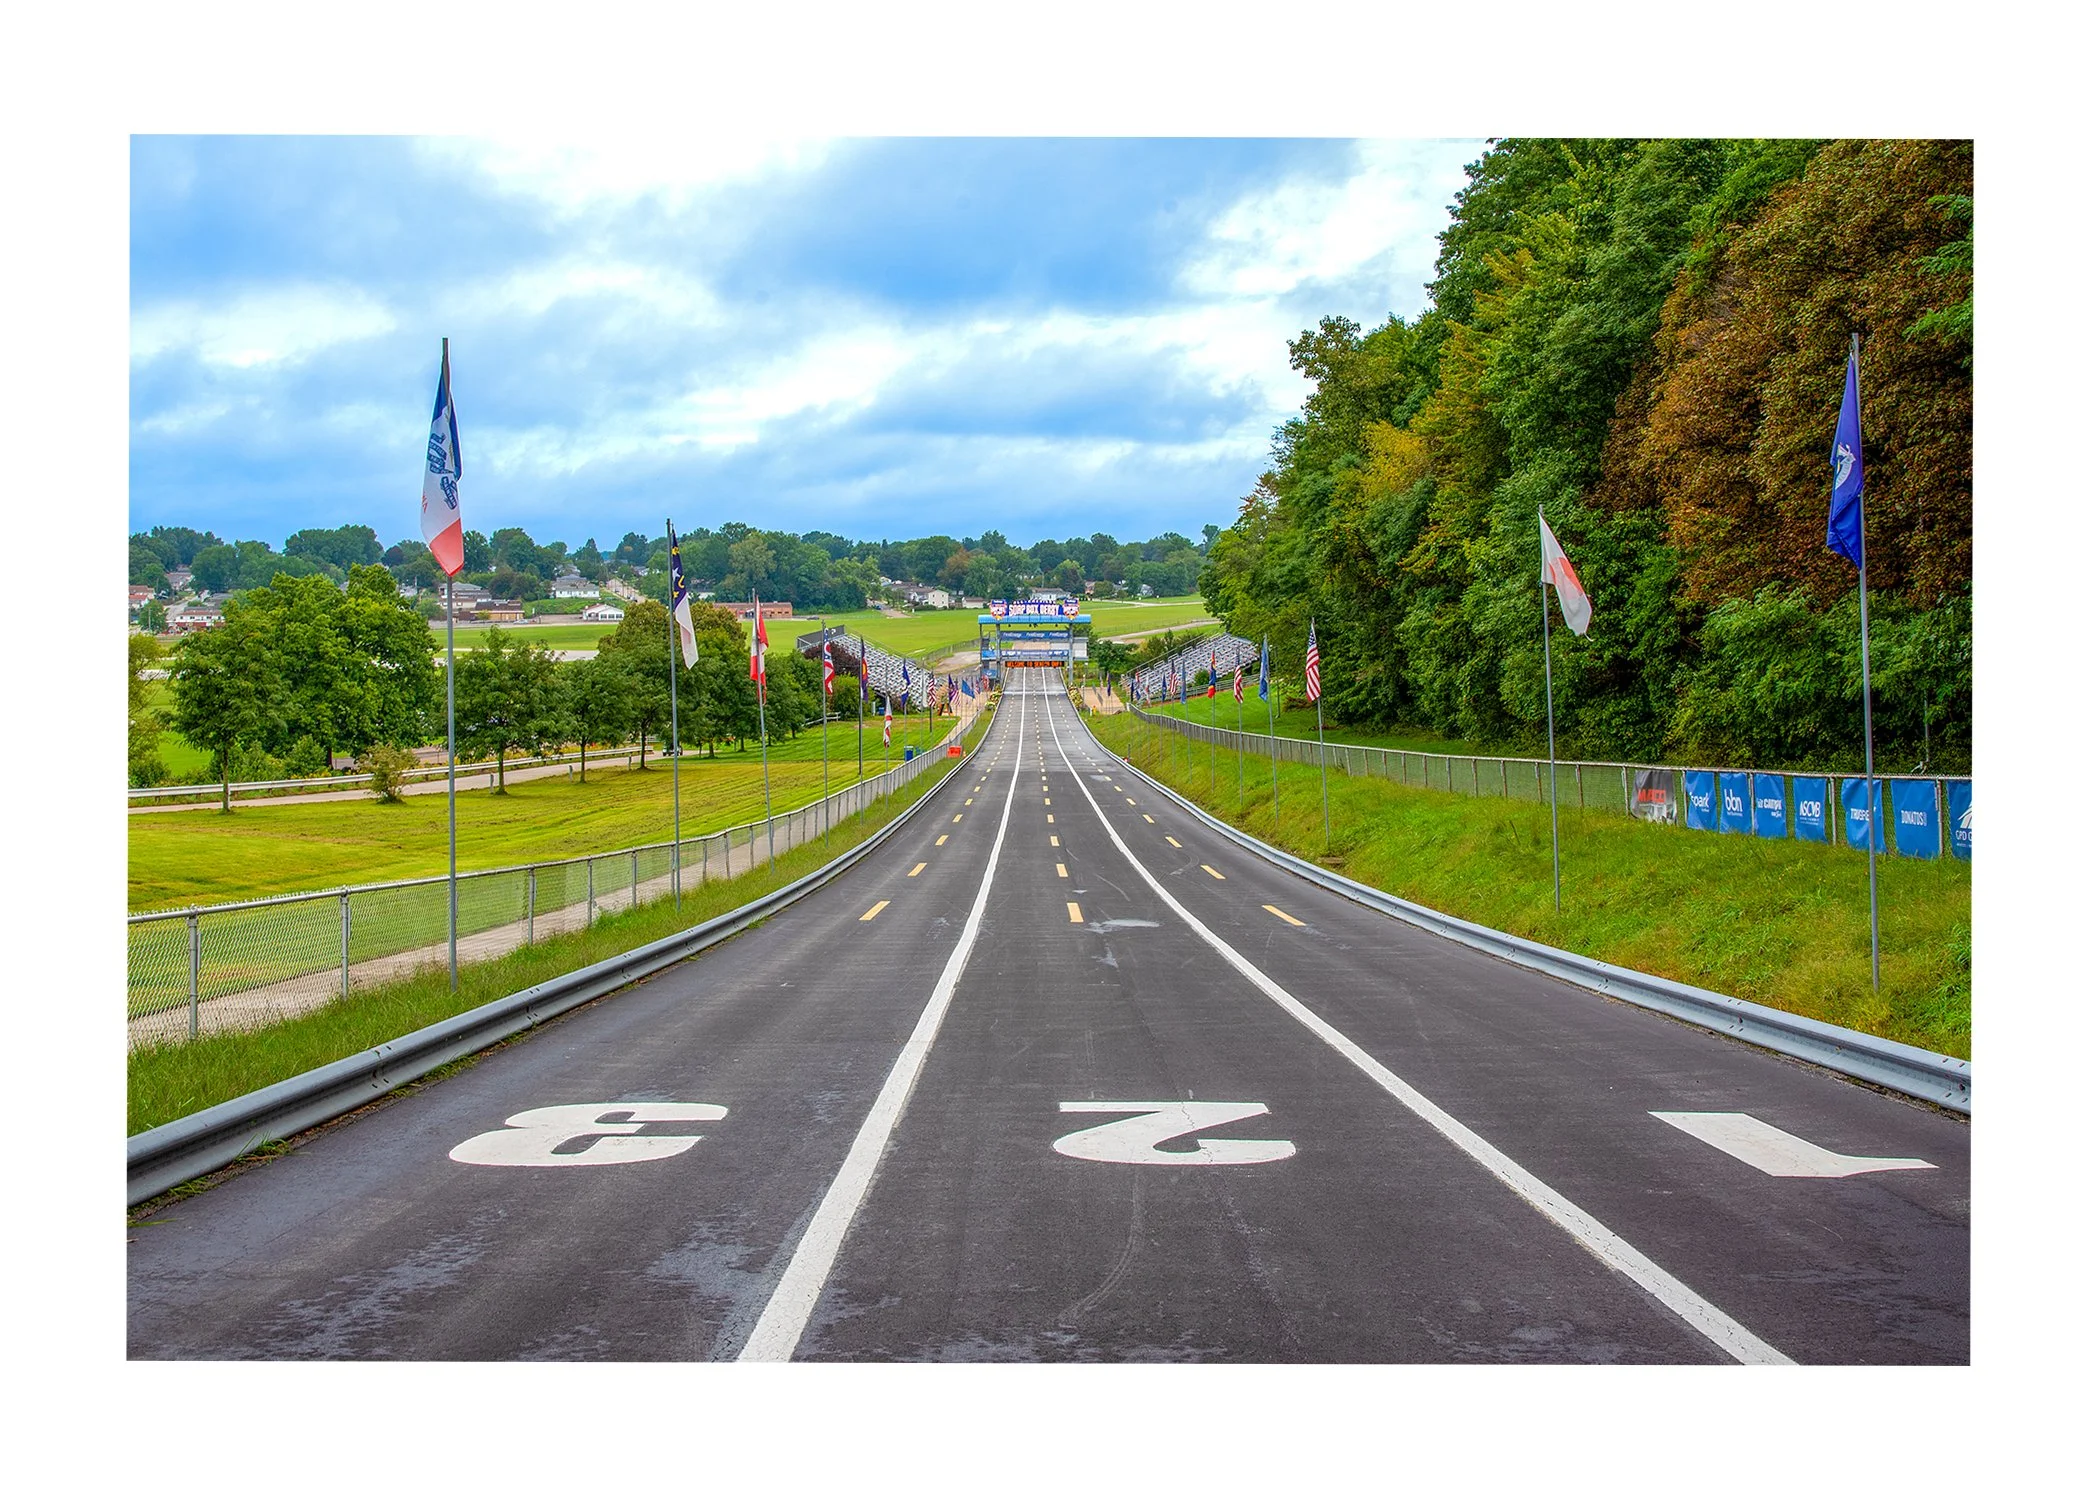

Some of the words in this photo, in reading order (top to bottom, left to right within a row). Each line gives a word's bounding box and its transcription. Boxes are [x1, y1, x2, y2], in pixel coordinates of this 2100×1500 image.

[1009, 604, 1025, 616] SOAP
[1026, 604, 1039, 616] BOX
[1040, 604, 1059, 616] DERBY
[448, 1102, 728, 1166] 3
[1052, 1101, 1296, 1165] 2
[1646, 1110, 1940, 1178] 1
